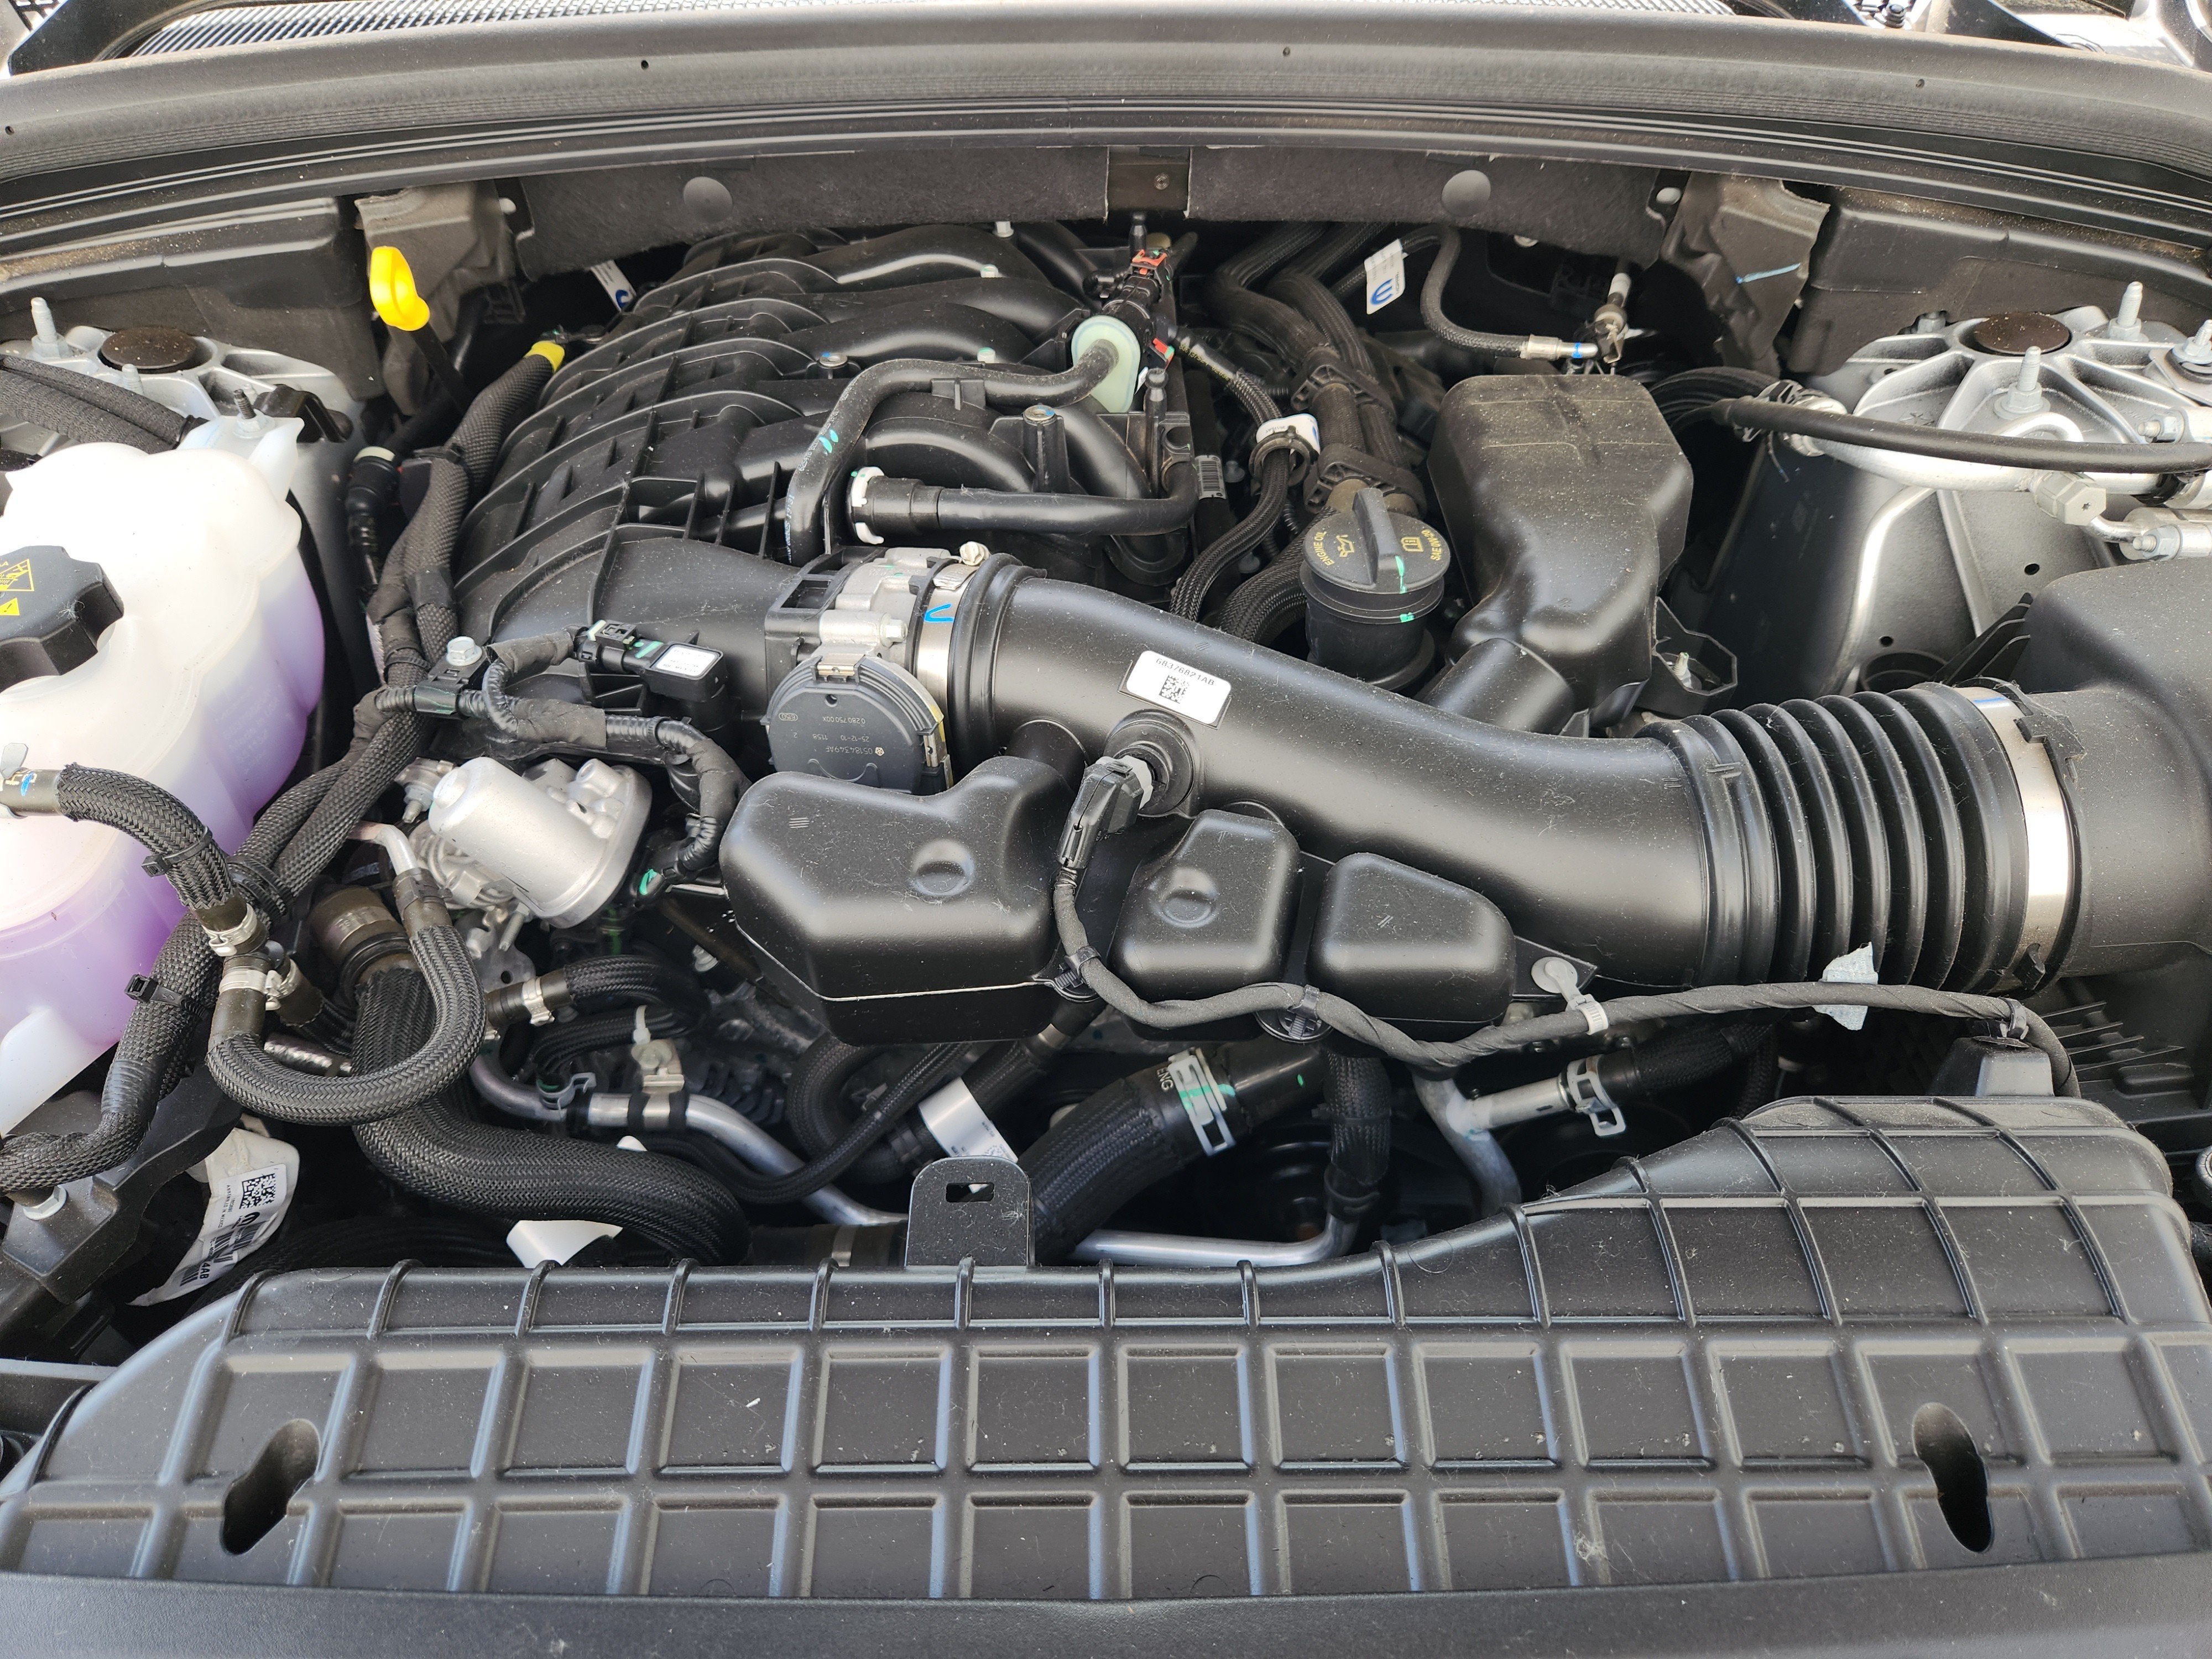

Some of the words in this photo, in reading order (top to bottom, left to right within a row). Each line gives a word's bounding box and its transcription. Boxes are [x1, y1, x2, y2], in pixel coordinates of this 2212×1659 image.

[1314, 531, 1327, 541] OIL
[1313, 542, 1335, 566] ENGINE
[1430, 547, 1442, 561] SAE
[1156, 658, 1214, 686] 68376821AB
[826, 745, 873, 755] 05184349AF
[1156, 1067, 1174, 1091] ENG
